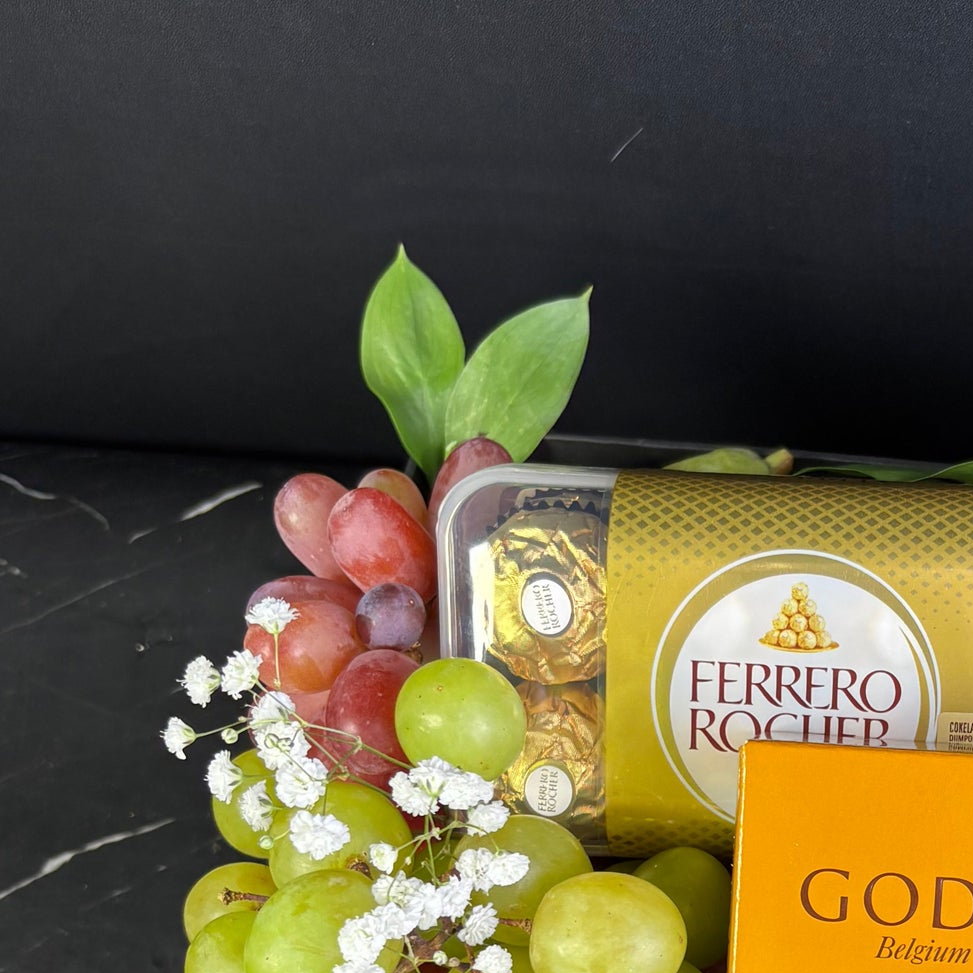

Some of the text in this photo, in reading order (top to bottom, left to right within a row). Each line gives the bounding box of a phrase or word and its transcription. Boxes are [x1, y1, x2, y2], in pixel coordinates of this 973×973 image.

[690, 660, 902, 713] FERRERO
[537, 768, 550, 812] FERRERO
[547, 770, 558, 812] ROCHER
[875, 936, 971, 965] Belgium
